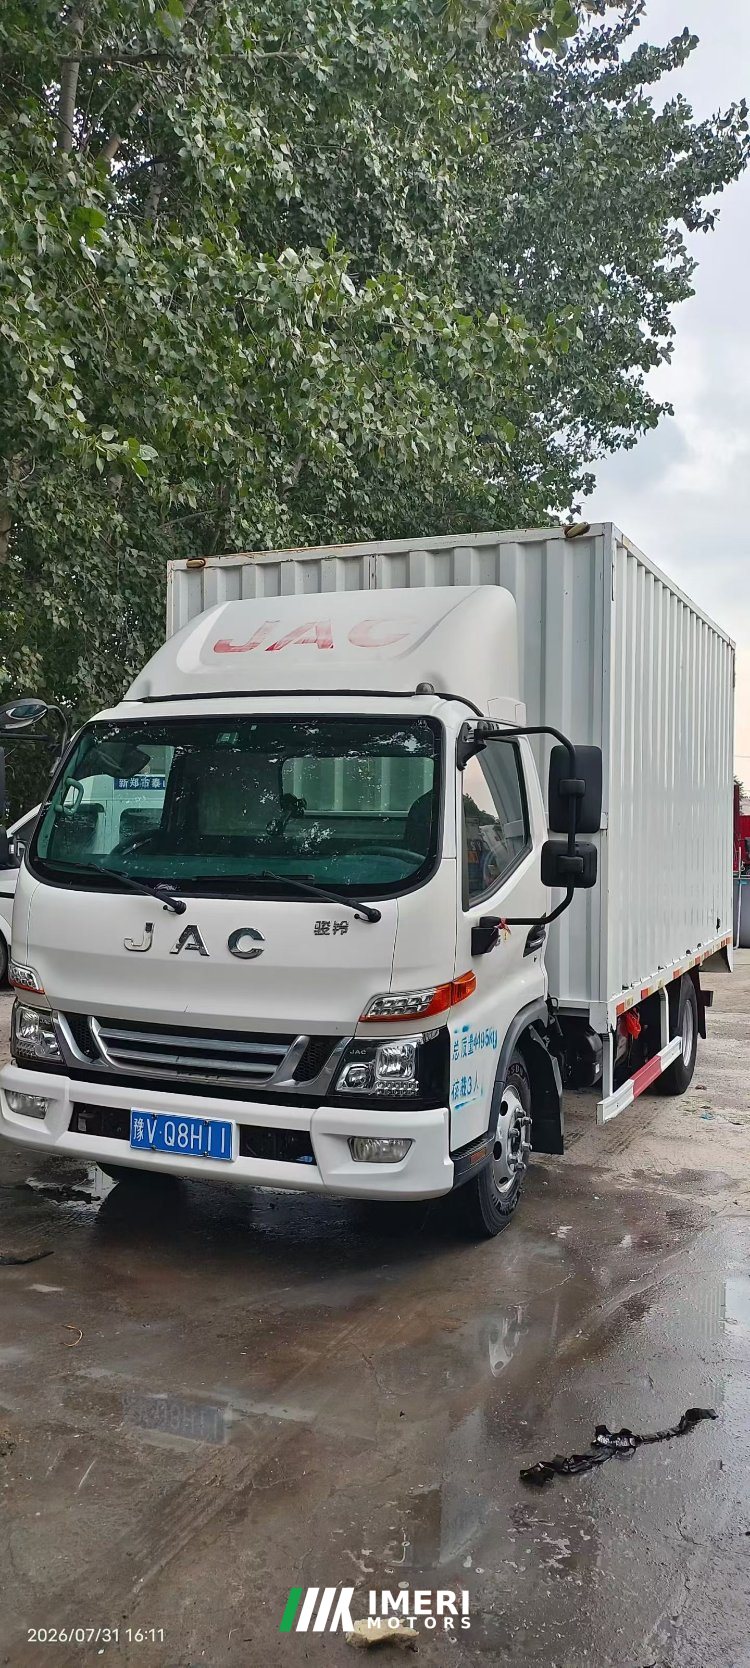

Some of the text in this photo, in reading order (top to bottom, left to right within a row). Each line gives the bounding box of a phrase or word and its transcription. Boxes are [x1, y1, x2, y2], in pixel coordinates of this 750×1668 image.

[213, 620, 412, 653] JAC
[123, 922, 266, 960] JAC
[313, 920, 349, 936] 骏铃
